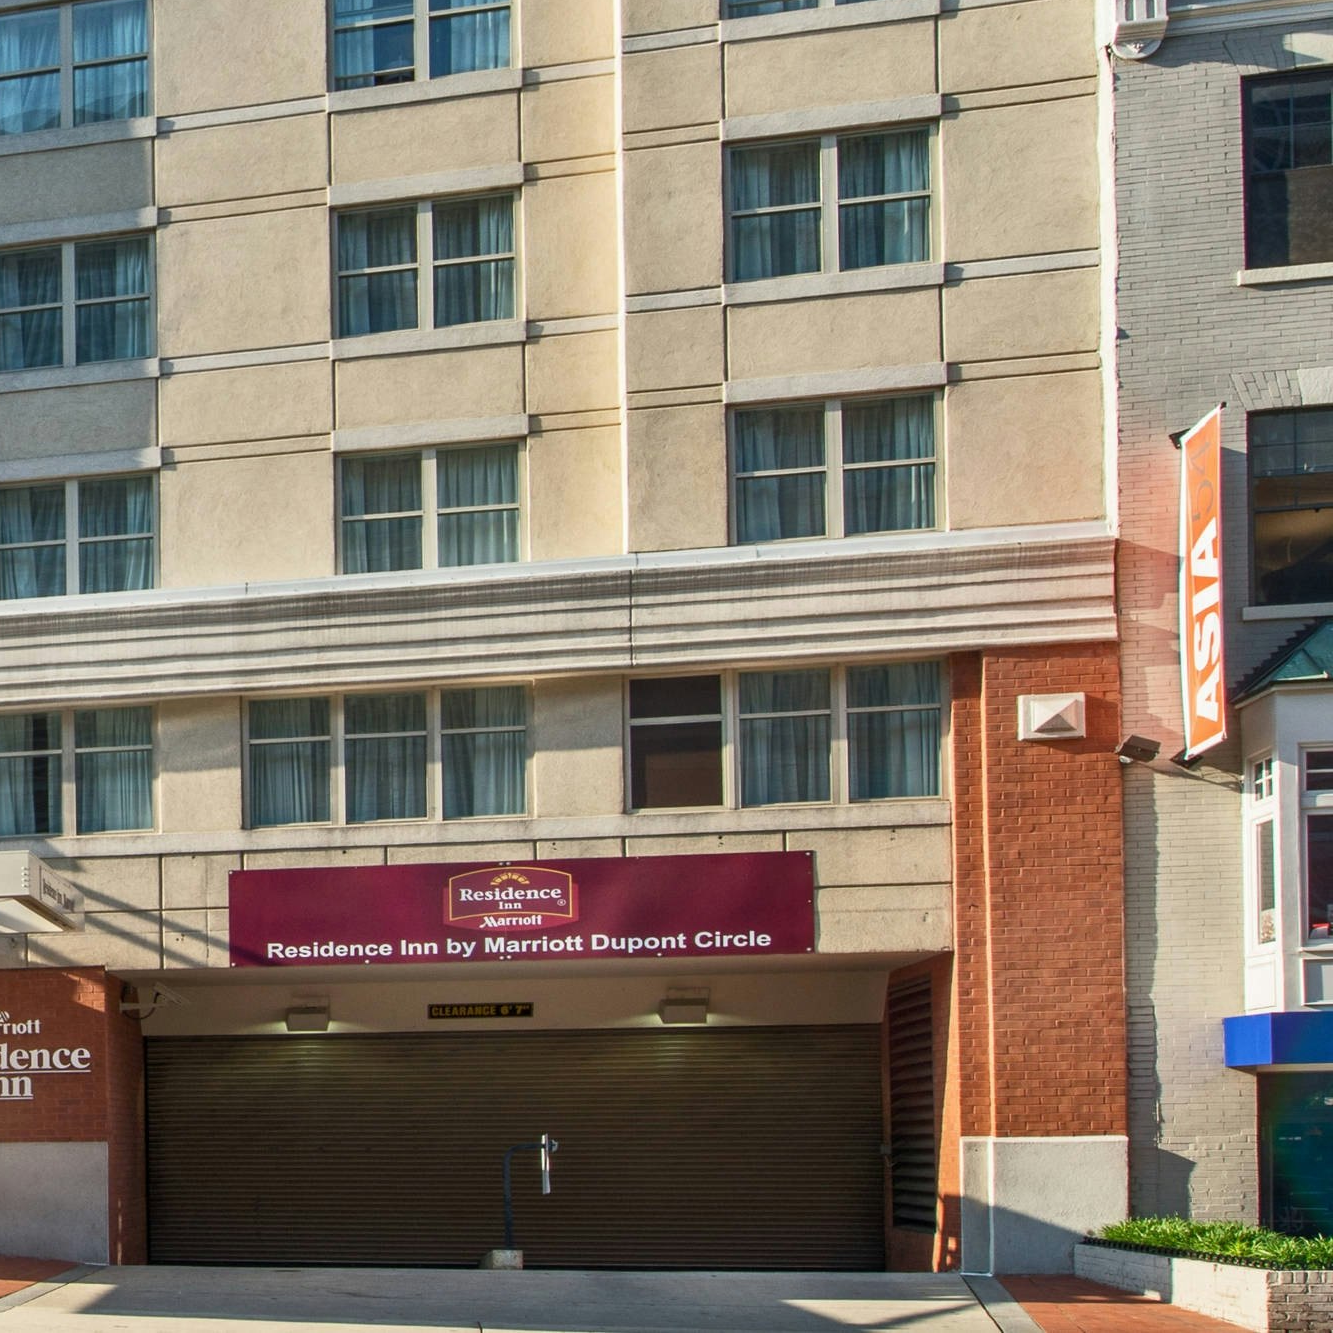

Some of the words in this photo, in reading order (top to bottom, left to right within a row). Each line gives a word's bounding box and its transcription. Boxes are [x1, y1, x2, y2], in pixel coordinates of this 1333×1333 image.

[1190, 440, 1215, 522] 54
[1191, 516, 1222, 723] ASIA
[459, 886, 562, 902] Residence
[498, 900, 523, 910] Inn
[478, 913, 543, 929] Marriott
[266, 940, 393, 959] Residence
[400, 939, 438, 955] Inn
[446, 938, 476, 957] by
[484, 934, 584, 954] Marriott
[590, 932, 687, 954] Dupont
[694, 930, 772, 949] Circle
[431, 1005, 497, 1016] CLEARANCE
